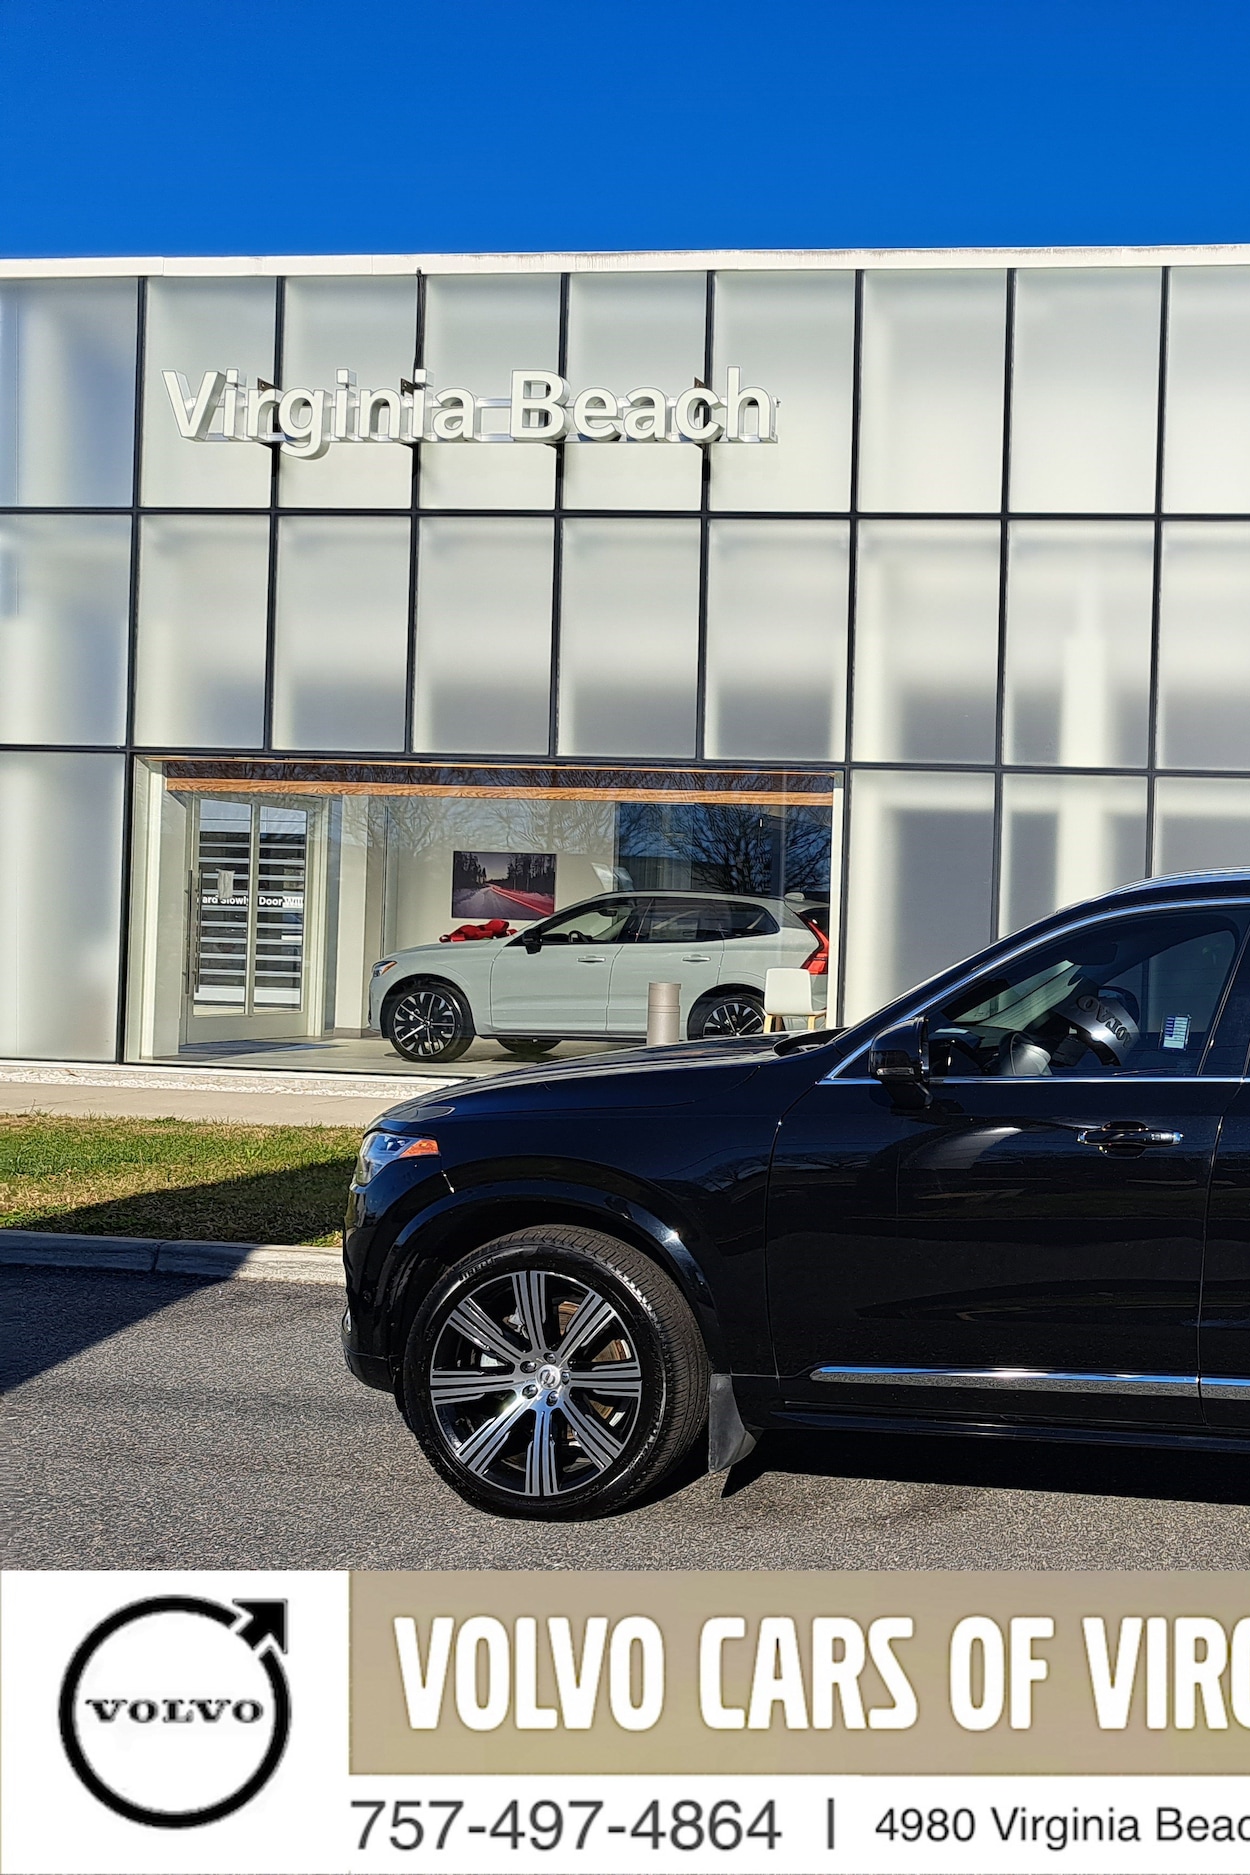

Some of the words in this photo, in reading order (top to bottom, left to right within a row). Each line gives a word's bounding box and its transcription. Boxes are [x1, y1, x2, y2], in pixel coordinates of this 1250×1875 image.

[162, 367, 478, 460] Virginia
[510, 366, 776, 443] Beach
[258, 896, 283, 906] Door
